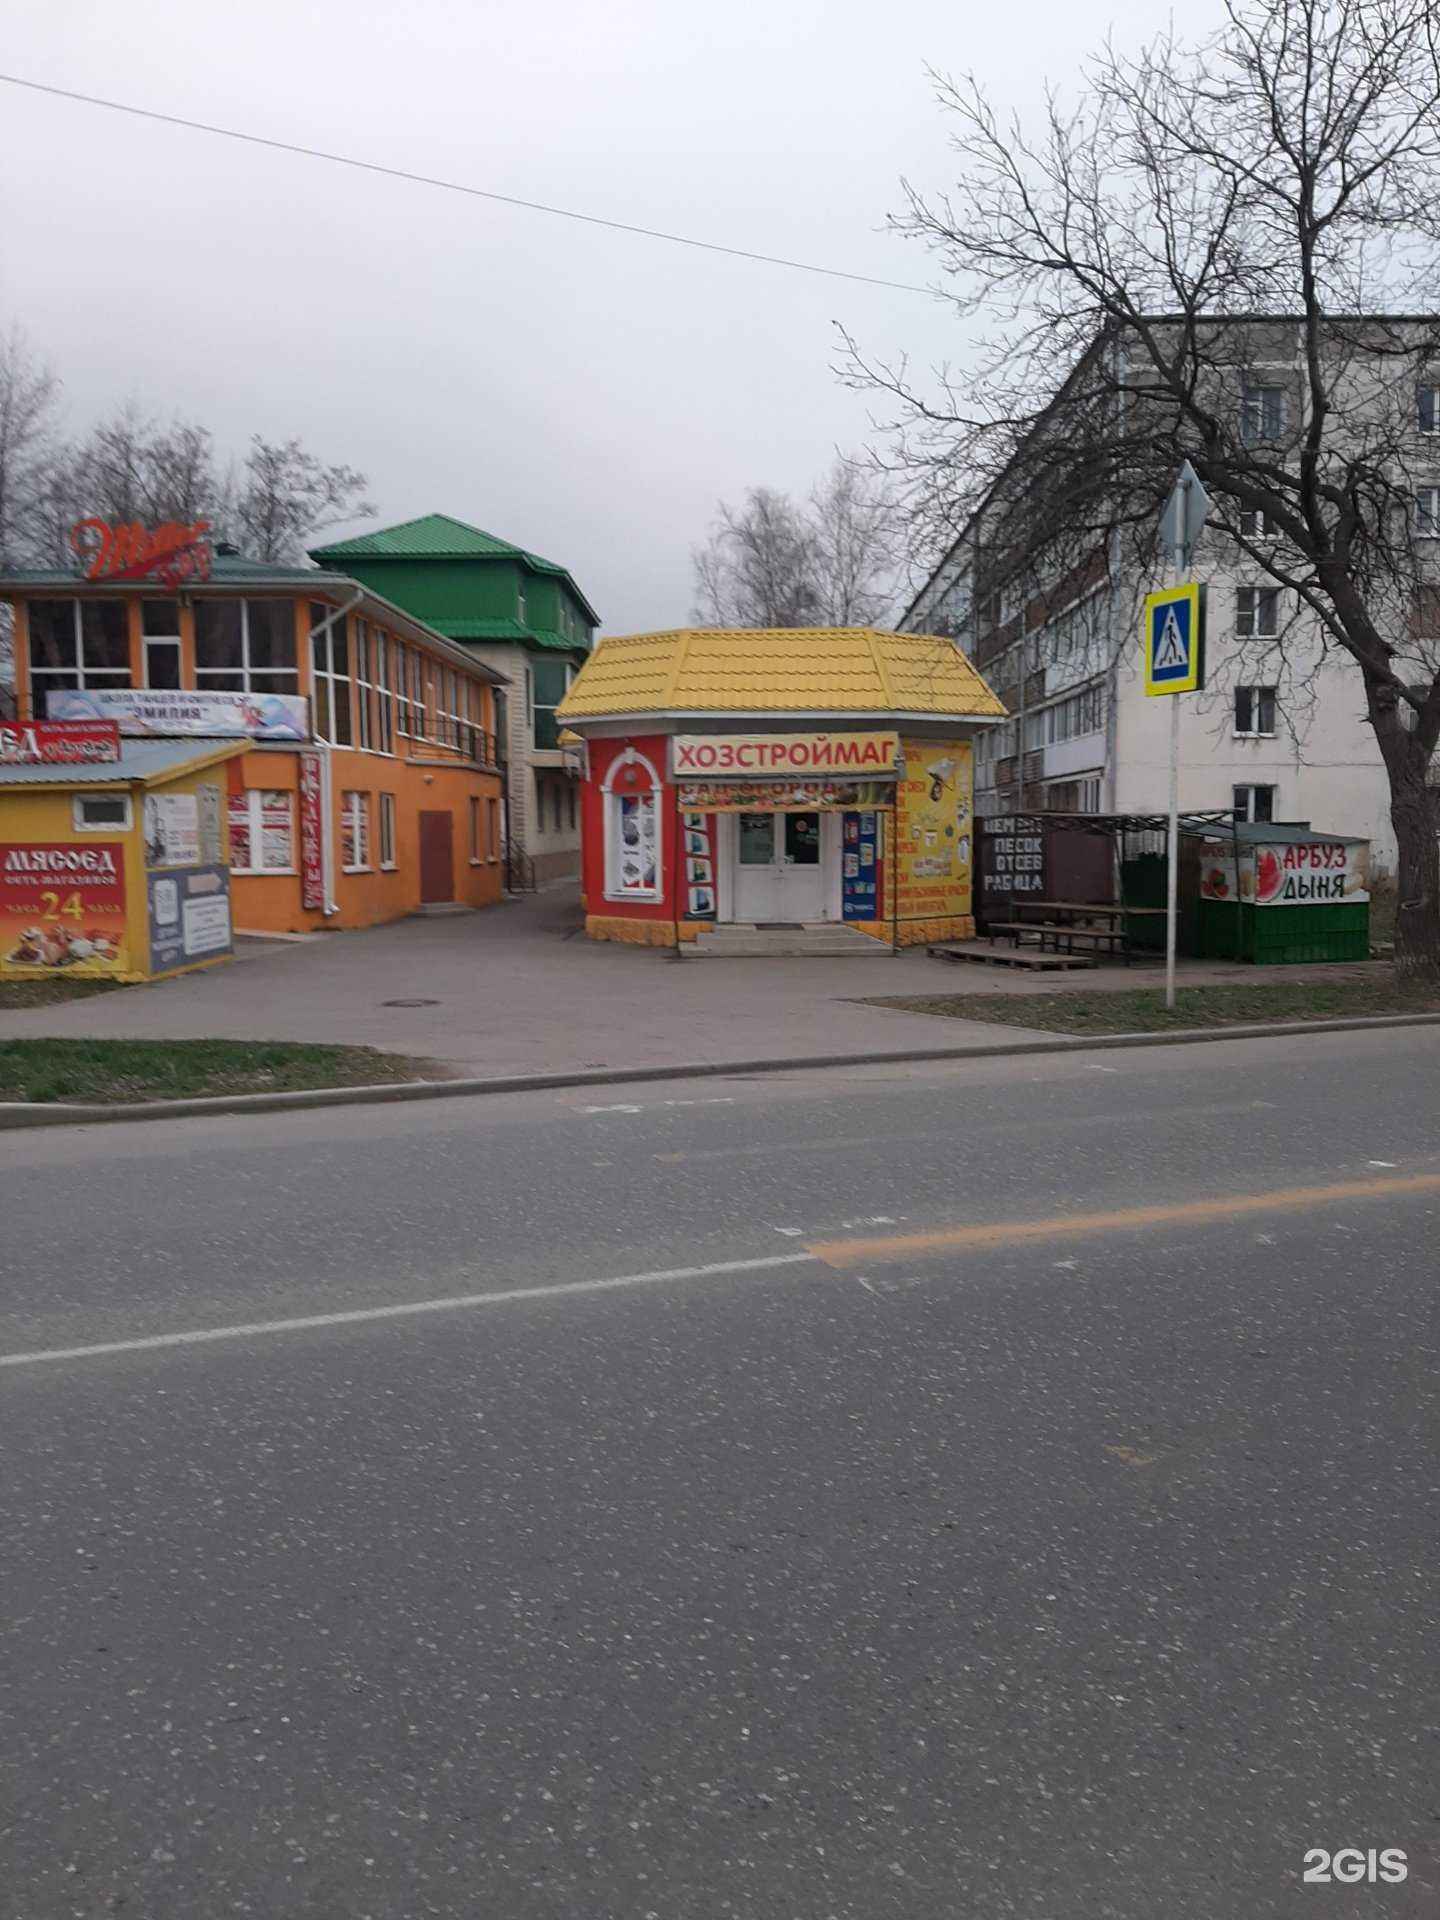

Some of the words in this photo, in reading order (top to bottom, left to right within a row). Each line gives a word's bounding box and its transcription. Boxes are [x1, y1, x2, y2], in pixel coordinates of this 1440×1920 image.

[678, 736, 895, 768] ХОЗСТРОЙМАГ
[995, 837, 1042, 853] ПЕСОК
[1283, 843, 1347, 869] АРБУЗ
[996, 855, 1042, 871] ОТСЕВ
[1283, 874, 1347, 900] ДЫНЯ
[41, 891, 85, 920] 24
